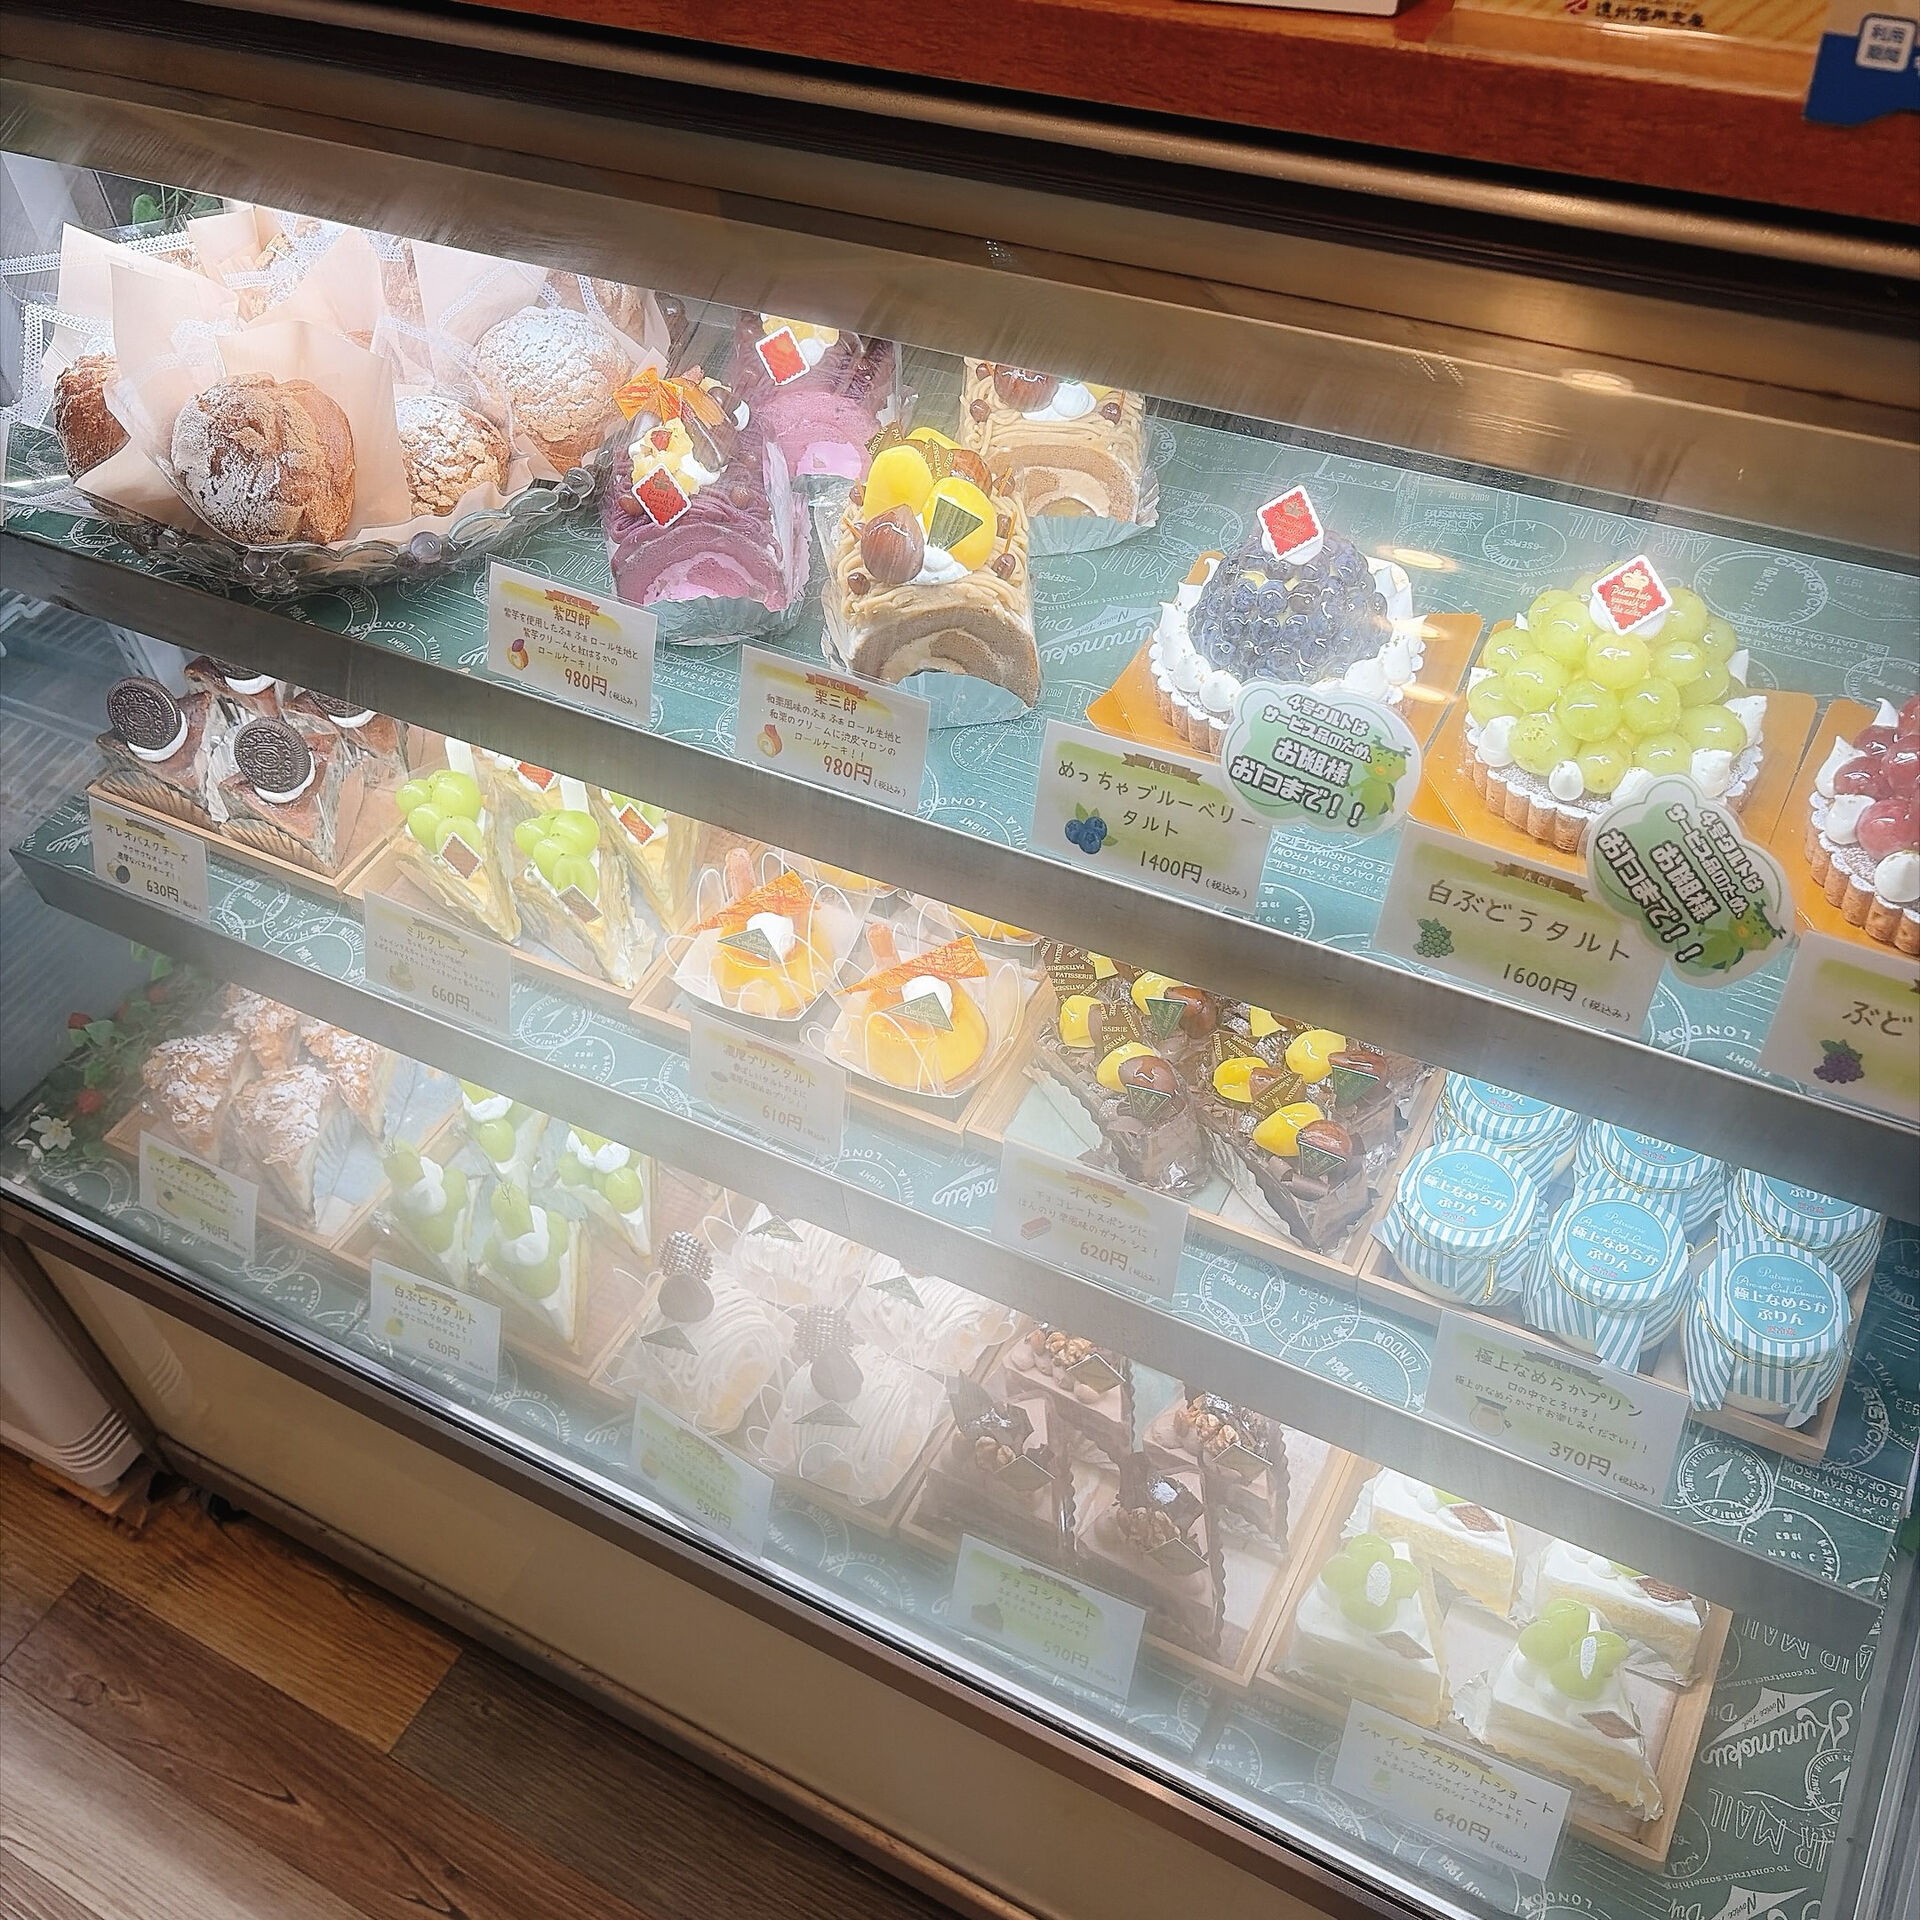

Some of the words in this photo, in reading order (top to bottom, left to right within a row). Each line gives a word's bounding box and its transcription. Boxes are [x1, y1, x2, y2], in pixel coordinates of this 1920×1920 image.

[1567, 511, 1649, 552] MAIL
[553, 605, 591, 630] 紫四郎
[1731, 624, 1762, 635] FRO
[564, 667, 608, 697] 980円
[672, 668, 699, 682] STAY
[814, 687, 858, 716] 栗三郎
[1287, 694, 1369, 737] 4号タルトは
[823, 755, 873, 785] 980円
[1058, 761, 1256, 825] めっちゃブルーベリー
[957, 816, 992, 837] FLIGHT
[1122, 808, 1179, 838] タルト
[1140, 851, 1202, 882] 1400円
[1272, 846, 1307, 863] FROM
[1308, 855, 1341, 872] STAY
[1355, 859, 1374, 870] OF
[1342, 865, 1374, 881] DAYS
[146, 879, 179, 903] 630円
[1427, 879, 1631, 964] 白ぶどうタルト
[407, 926, 469, 959] ミルクレープ
[1502, 964, 1578, 1002] 1600円
[431, 984, 470, 1013] 660円
[761, 1105, 803, 1133] 610円
[1069, 1185, 1113, 1209] オペラ
[1422, 1173, 1508, 1212] 極上なめらか
[1436, 1198, 1478, 1218] ぷりん
[1079, 1241, 1130, 1272] 620円
[1571, 1224, 1659, 1269] 極上なめらか
[1586, 1250, 1630, 1274] ぷりん
[394, 1285, 477, 1325] 白ぶどうタルト
[1733, 1285, 1829, 1315] 極上なめらか
[1757, 1307, 1804, 1327] ぷりん
[1474, 1347, 1643, 1417] 極上なめらかプリン
[1548, 1441, 1612, 1478] 370円
[1783, 1462, 1820, 1481] FROM
[1821, 1476, 1854, 1495] STAY
[1855, 1487, 1890, 1508] DAYS
[1866, 1482, 1886, 1495] OF
[1700, 1698, 1854, 1770] Kumimoku
[1358, 1721, 1554, 1815] シャインマスカットショート
[1433, 1807, 1491, 1843] 640円
[1707, 1787, 1786, 1855] MAIL
[1665, 1874, 1721, 1892] something
[1723, 1865, 1775, 1882] construct
